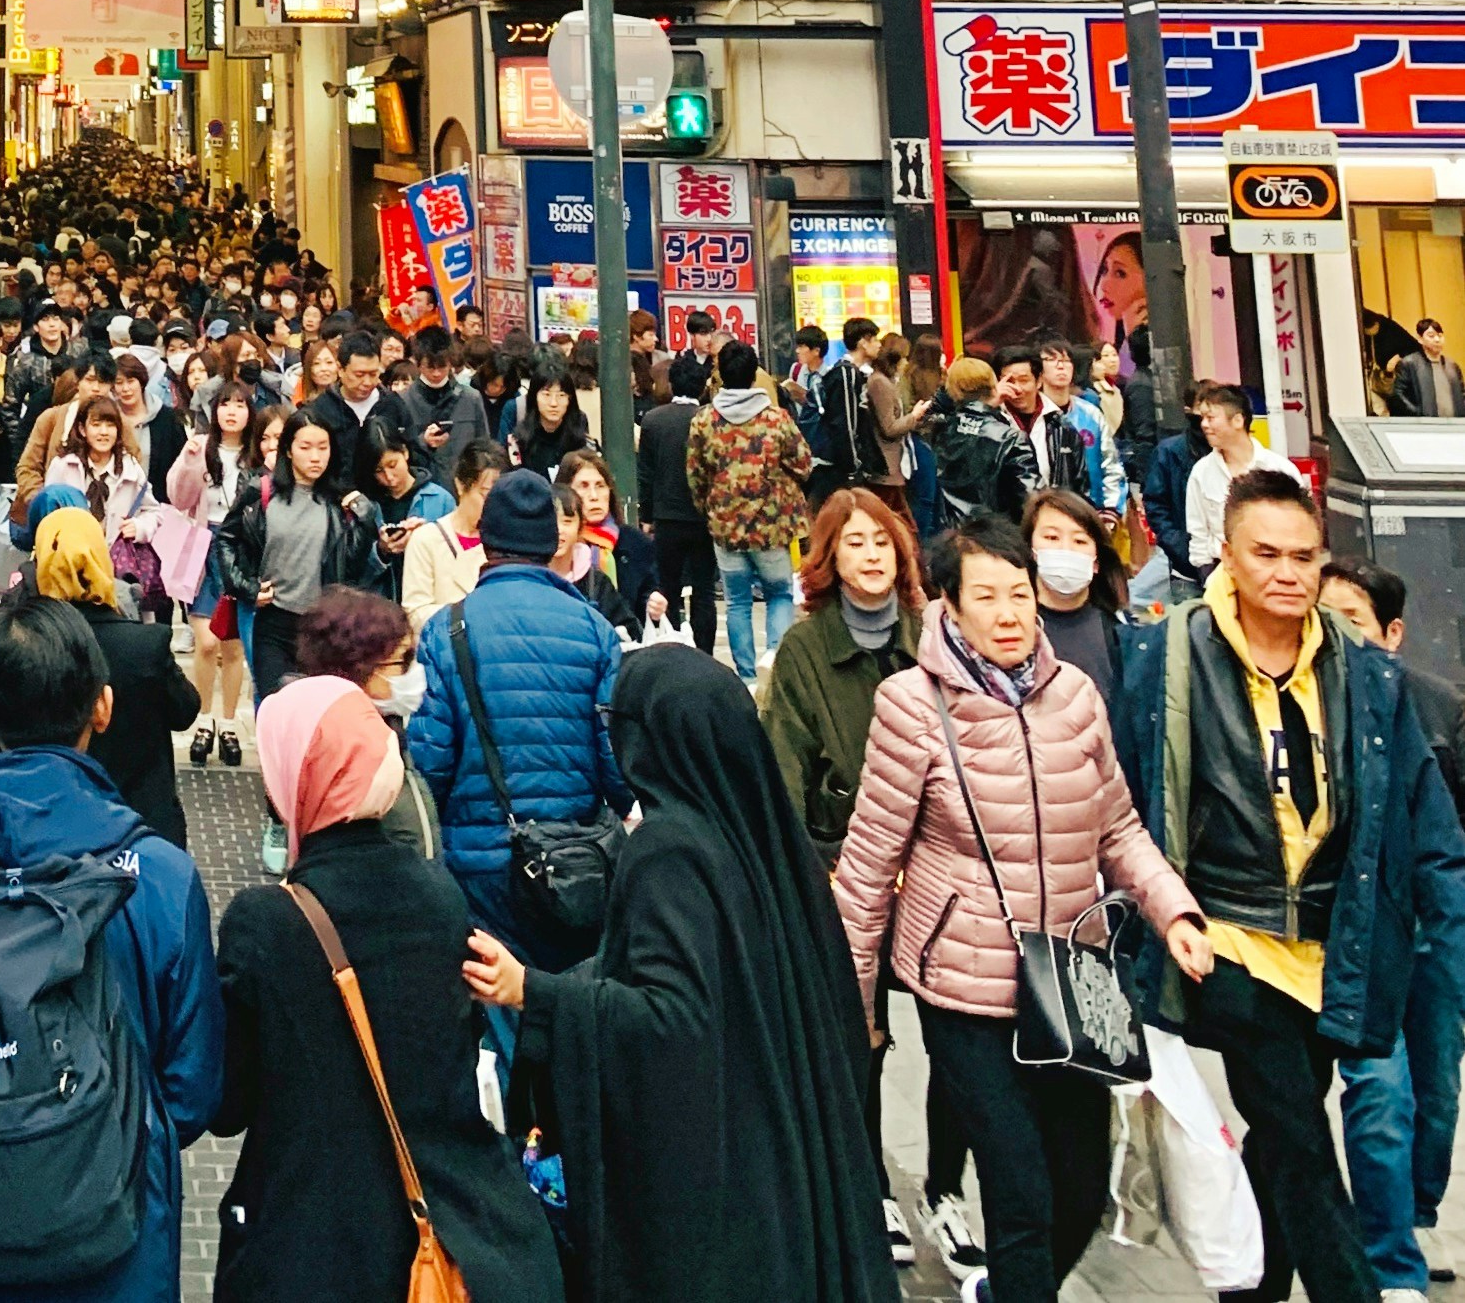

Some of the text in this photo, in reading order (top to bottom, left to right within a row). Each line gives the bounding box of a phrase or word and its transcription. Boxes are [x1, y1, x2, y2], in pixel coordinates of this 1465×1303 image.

[963, 18, 1077, 131] 薬
[676, 165, 733, 219] 薬
[419, 186, 470, 235] 薬
[547, 202, 595, 224] BOSS
[554, 223, 590, 234] COFFEE
[789, 217, 886, 233] CURRENCY
[665, 232, 750, 265] ダイコク
[790, 238, 889, 254] EXCHANGE
[1261, 228, 1318, 247] 大阪市
[676, 267, 738, 290] ドラッグ
